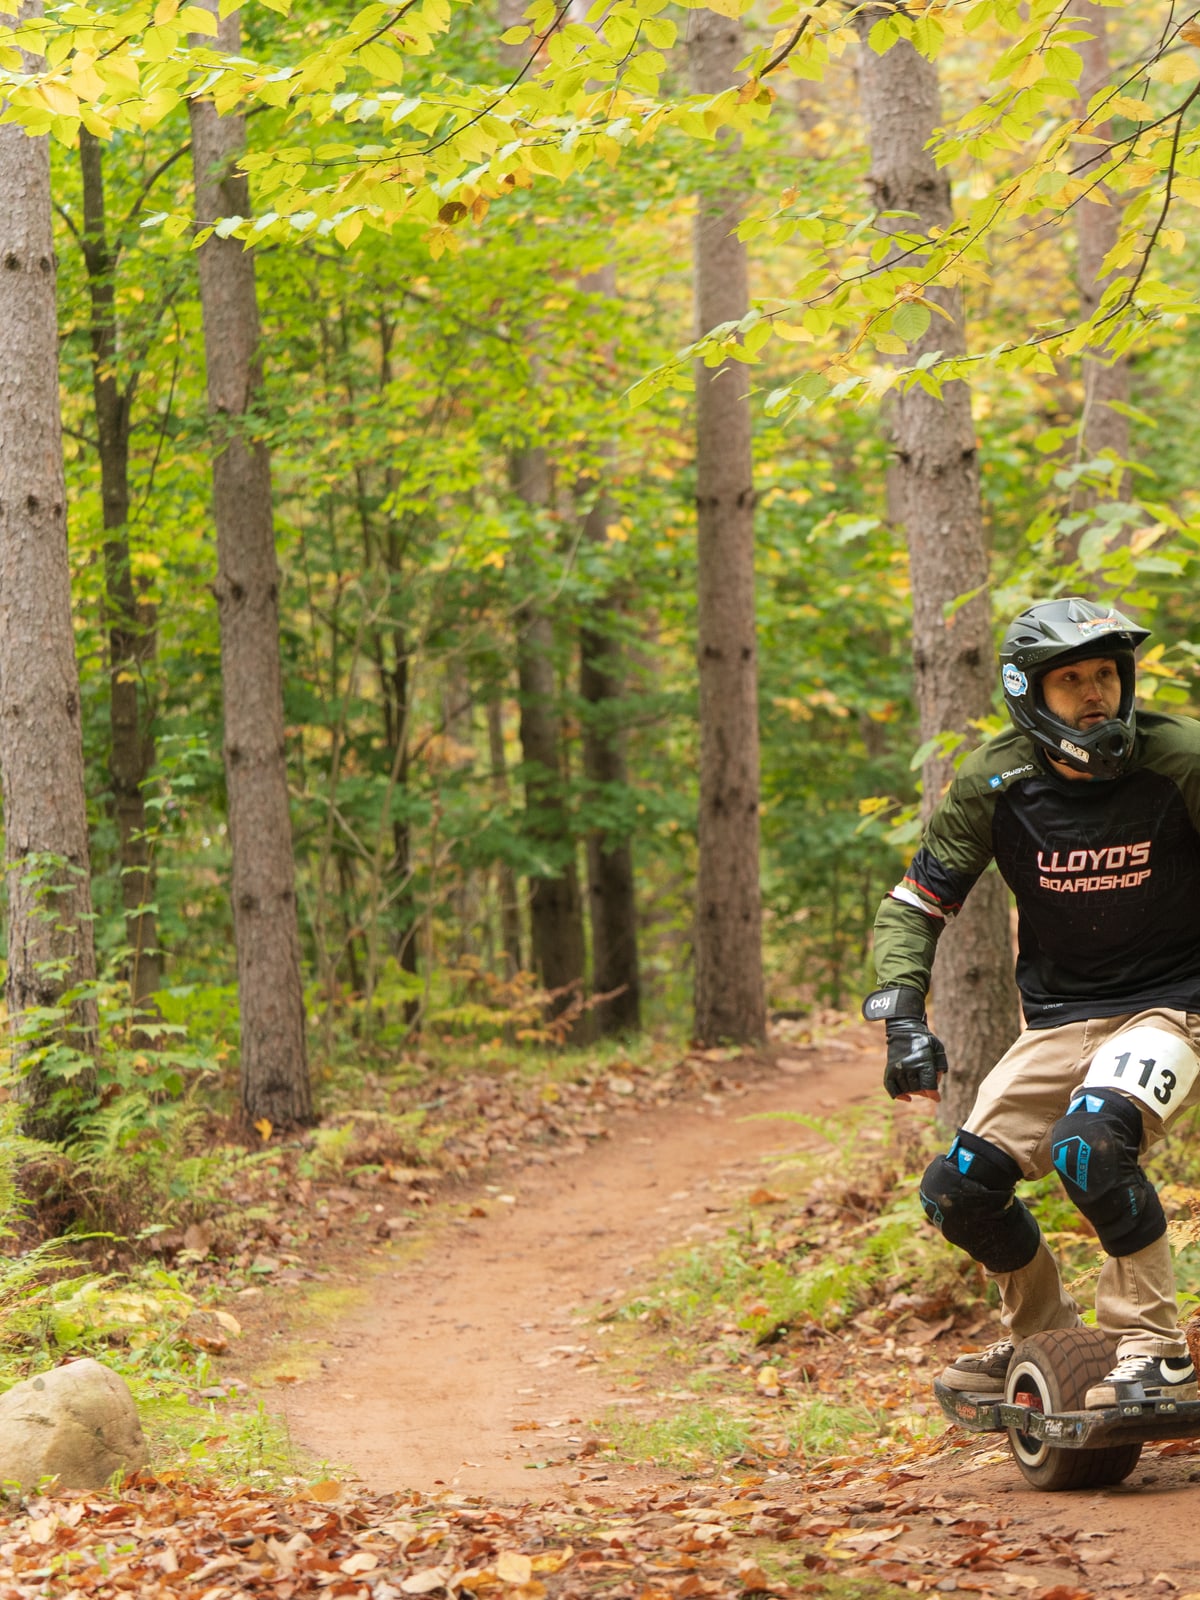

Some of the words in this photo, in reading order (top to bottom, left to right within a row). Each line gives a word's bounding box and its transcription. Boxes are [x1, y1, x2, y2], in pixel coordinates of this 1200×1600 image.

[1037, 841, 1152, 873] LLOYD'S
[1039, 868, 1152, 893] BOARDSHOP
[1113, 1051, 1177, 1105] 113
